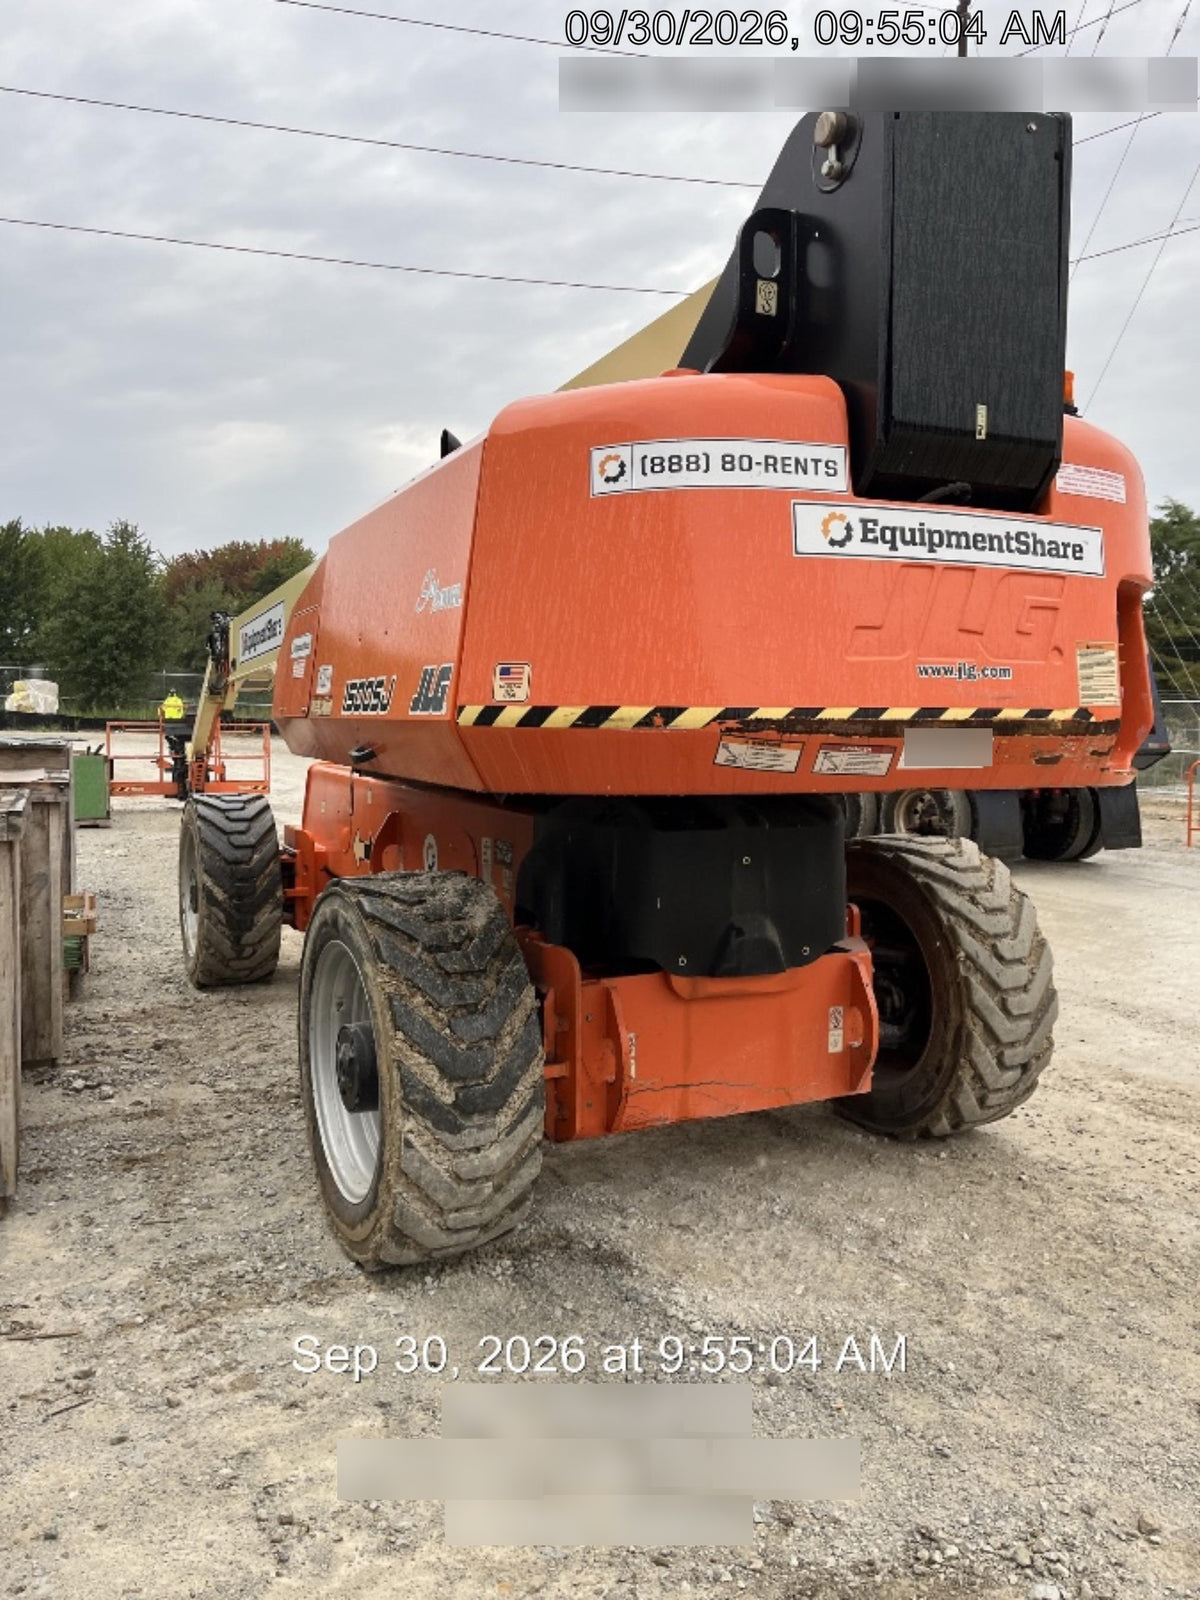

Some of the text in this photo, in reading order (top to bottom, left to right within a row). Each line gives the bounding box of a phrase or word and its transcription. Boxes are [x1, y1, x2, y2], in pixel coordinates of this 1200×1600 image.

[640, 452, 839, 478] (888) 80-RENTS
[858, 517, 1084, 561] EquipmentShare
[409, 663, 454, 715] JLG
[917, 662, 1012, 681] www.jlg.com
